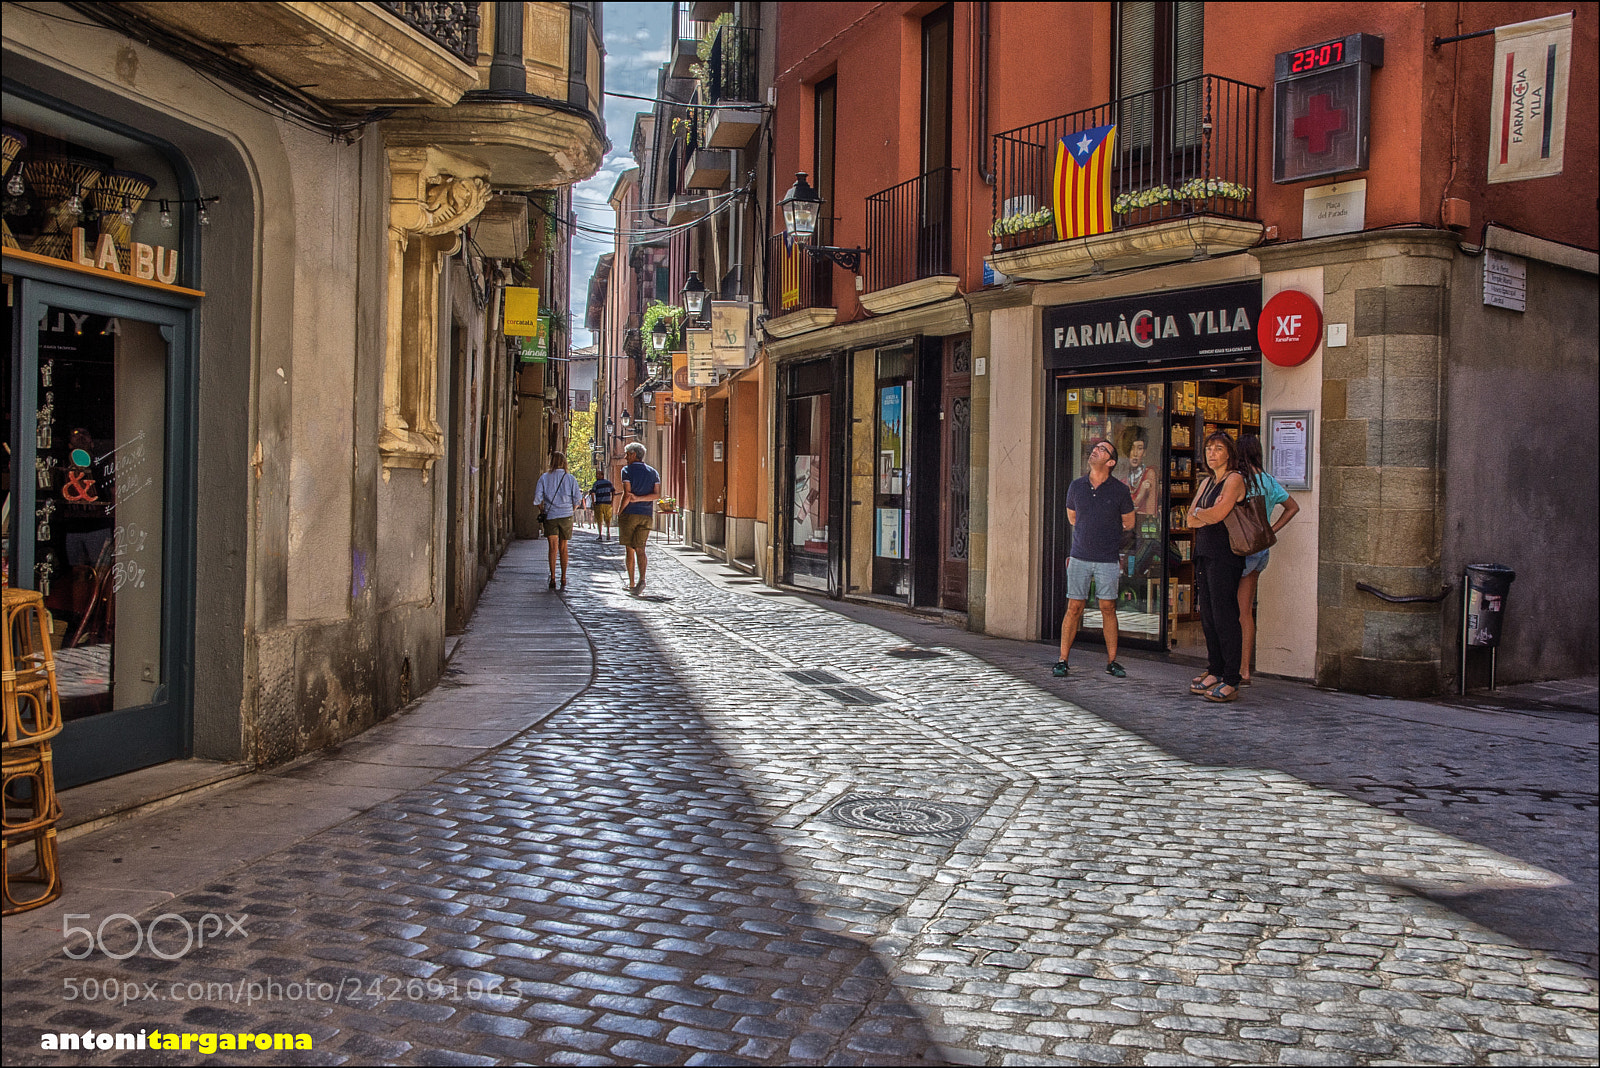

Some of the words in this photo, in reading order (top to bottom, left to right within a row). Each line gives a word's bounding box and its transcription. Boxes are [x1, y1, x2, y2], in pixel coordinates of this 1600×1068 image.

[1512, 68, 1529, 143] FARMÀCIA
[1530, 86, 1543, 119] YLLA
[72, 227, 120, 273] LA
[131, 242, 178, 284] BU
[1054, 309, 1180, 349] FARMÀCIA
[1188, 307, 1251, 335] YLLA
[1275, 315, 1302, 336] XF
[112, 560, 145, 593] 30%
